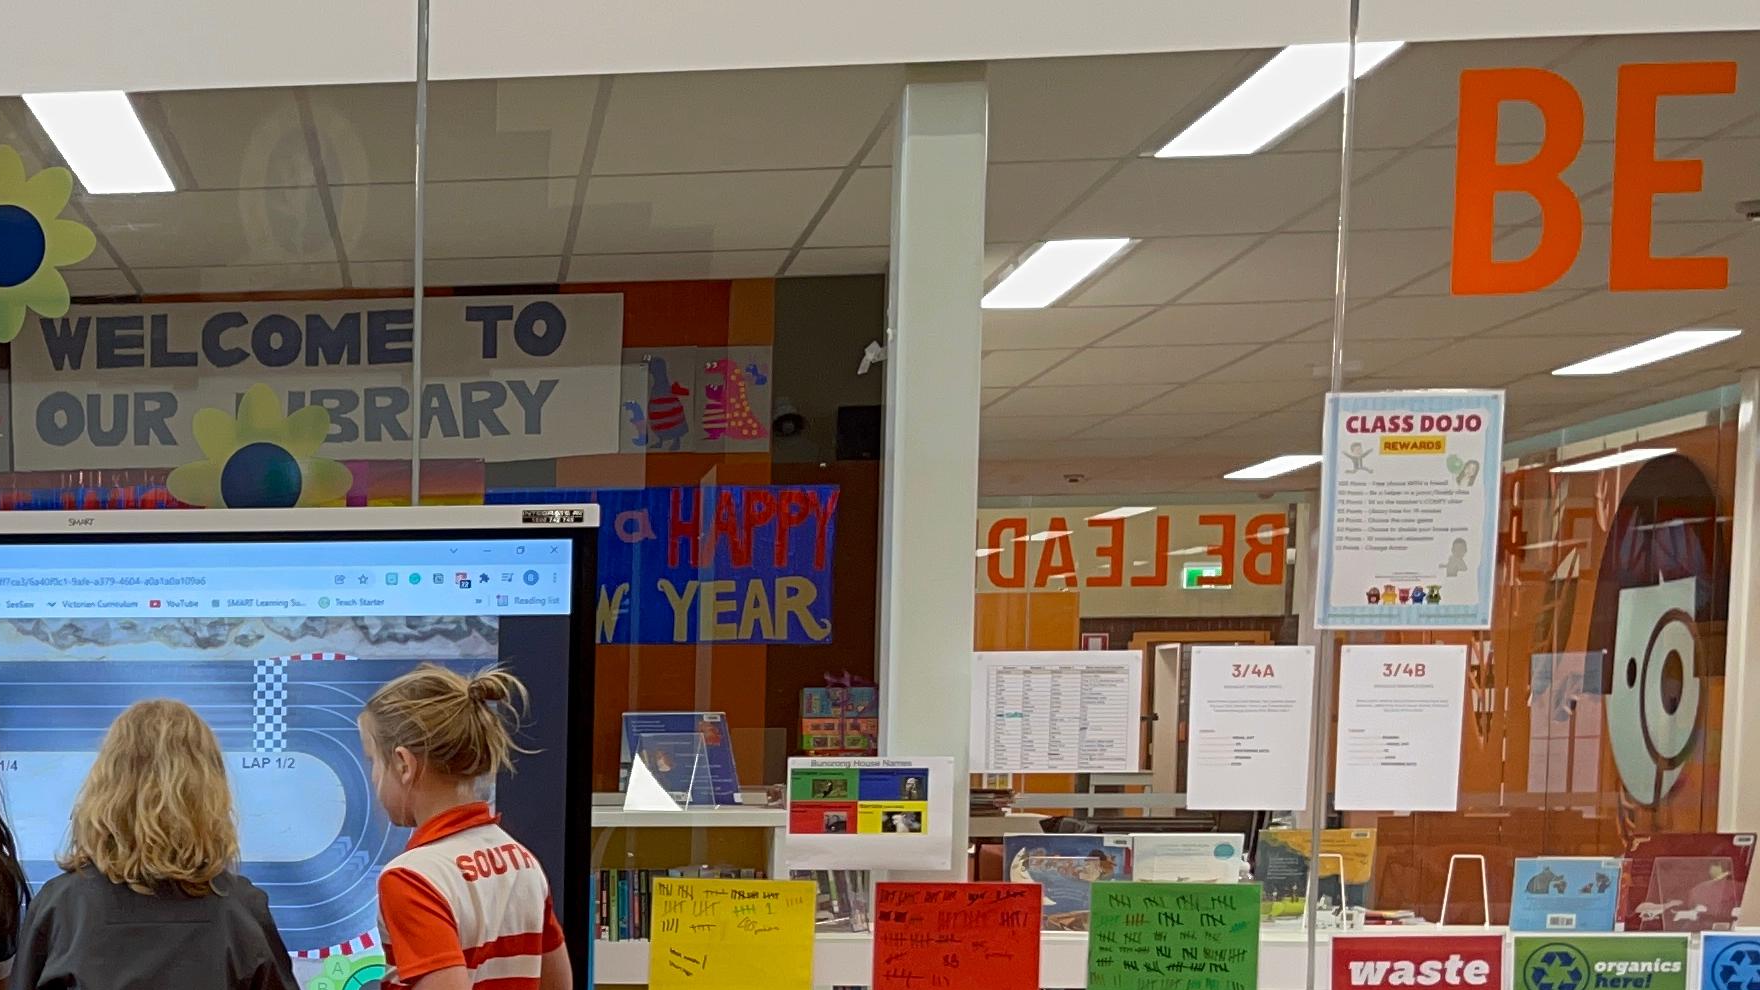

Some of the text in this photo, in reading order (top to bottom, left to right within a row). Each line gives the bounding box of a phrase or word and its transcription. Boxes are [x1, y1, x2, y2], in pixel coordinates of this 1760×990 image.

[1451, 61, 1738, 297] BE
[40, 301, 567, 371] WELCOME TO
[36, 379, 560, 447] OUR BRARY
[1346, 414, 1482, 433] CLASS DOJO
[1383, 441, 1442, 451] REWARDS
[68, 518, 96, 527] SMART
[667, 488, 840, 570] HAPPY
[166, 600, 199, 609] YouTube
[227, 599, 254, 608] SMART
[256, 599, 289, 610] Learning
[360, 597, 385, 607] Starter
[514, 596, 560, 606] Reading list
[657, 576, 832, 642] YEAR
[1232, 663, 1275, 678] 3/4A
[1383, 663, 1426, 677] 3/4B
[0, 760, 18, 772] 1/4
[242, 757, 296, 769] LAP 1/2
[1349, 954, 1491, 986] waste
[1594, 957, 1682, 975] organics
[1594, 973, 1652, 989] here!
